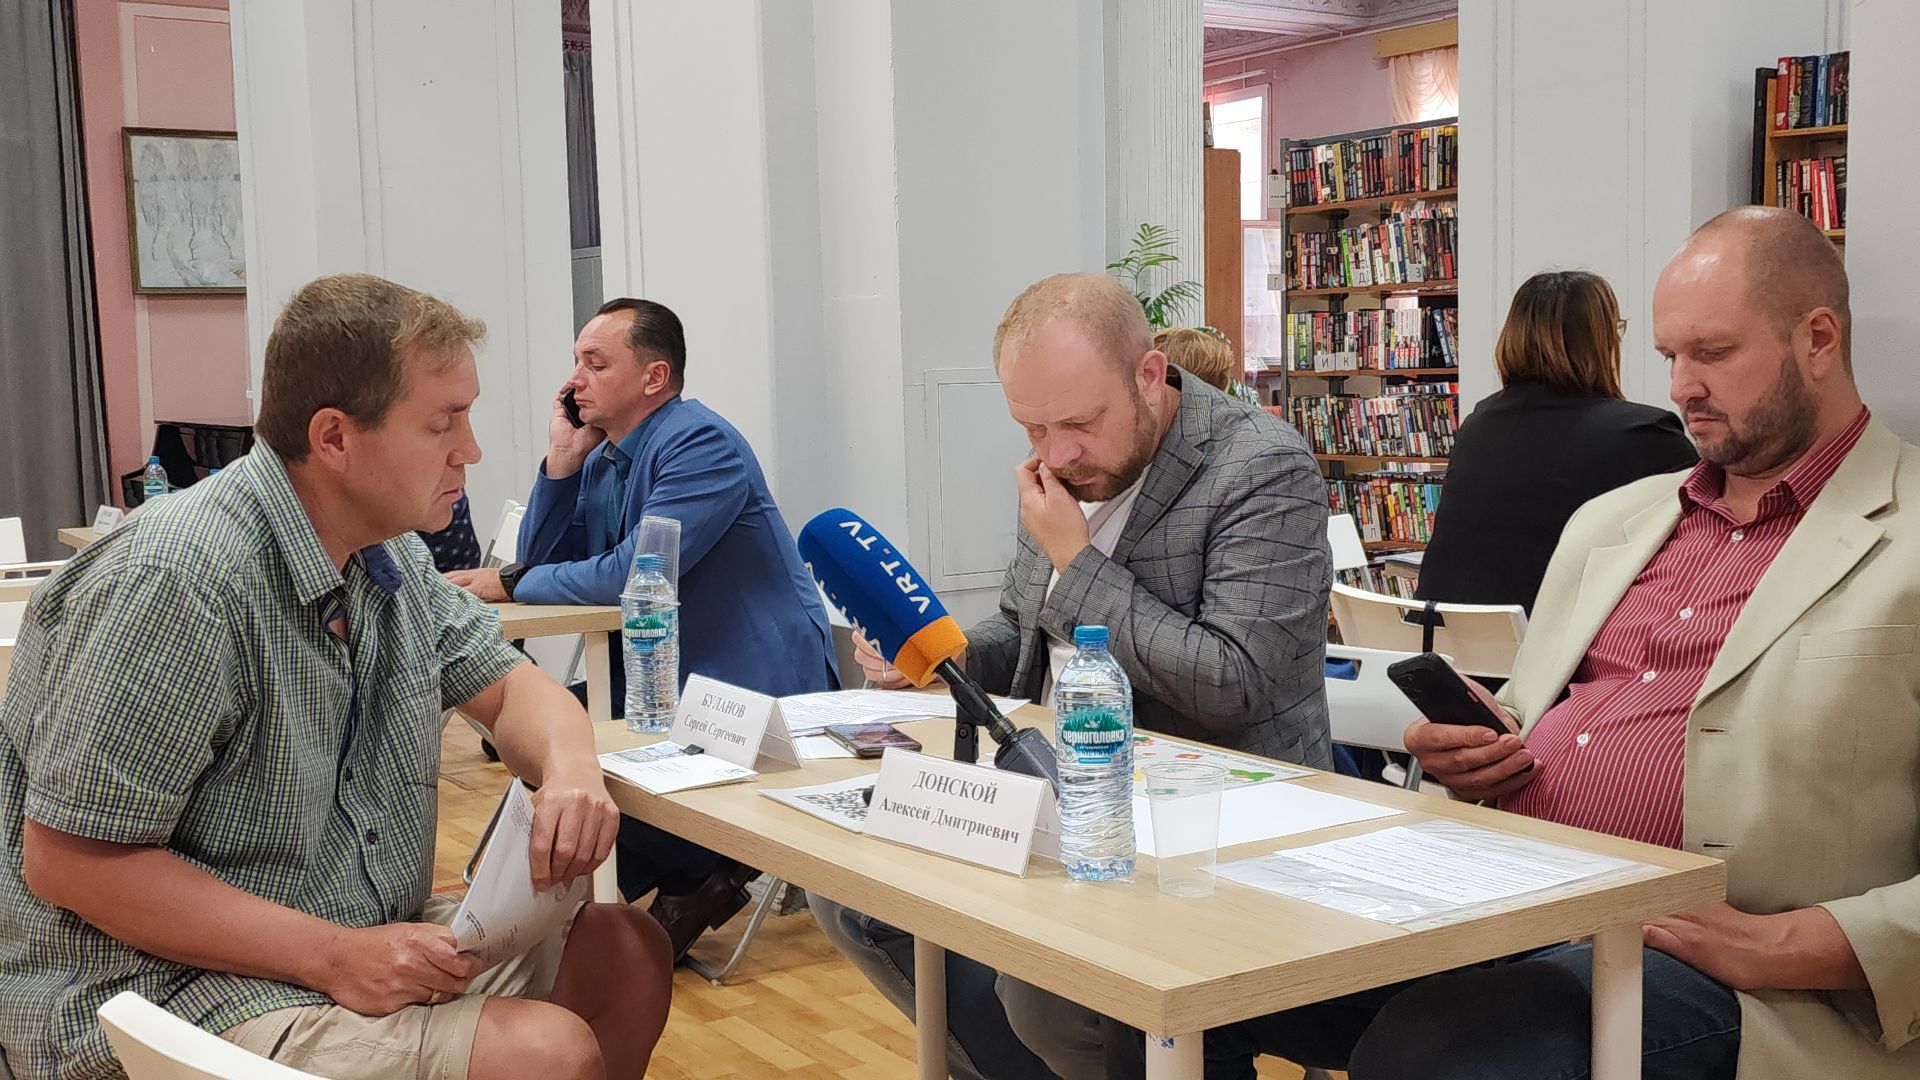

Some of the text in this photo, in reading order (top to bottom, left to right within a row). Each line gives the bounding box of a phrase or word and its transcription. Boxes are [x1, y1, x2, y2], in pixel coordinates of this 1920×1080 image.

[838, 521, 931, 614] VRT-TV
[701, 693, 746, 718] БУЛАНОВ
[684, 713, 747, 747] Сергей Сергеевич
[912, 770, 999, 805] ДОНСКОЙ
[878, 795, 1020, 844] Алексей Дмитриевич
